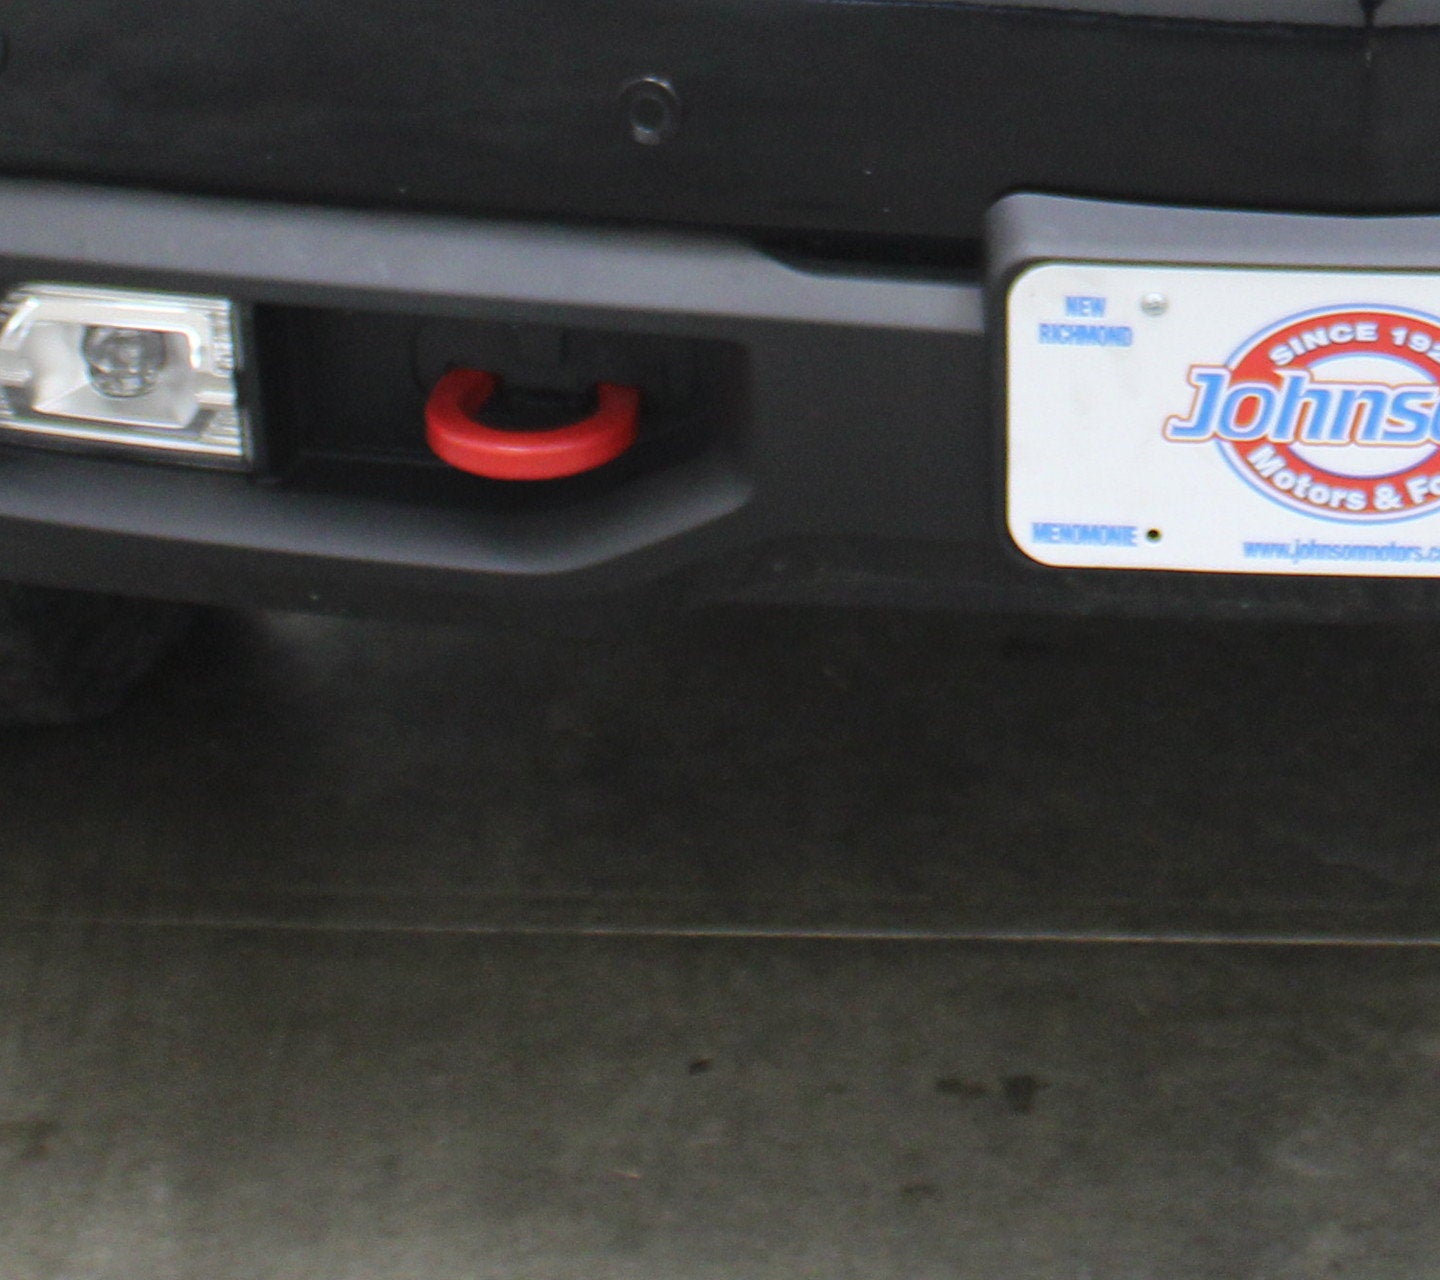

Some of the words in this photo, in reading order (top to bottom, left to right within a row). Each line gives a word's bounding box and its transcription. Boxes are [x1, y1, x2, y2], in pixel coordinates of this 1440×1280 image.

[1066, 297, 1105, 317] NEW
[1040, 323, 1132, 346] RICHMOND
[1268, 322, 1379, 366] SINCE
[1247, 444, 1367, 511] Motors
[1373, 483, 1404, 511] &
[1032, 523, 1137, 546] MENOMONIE
